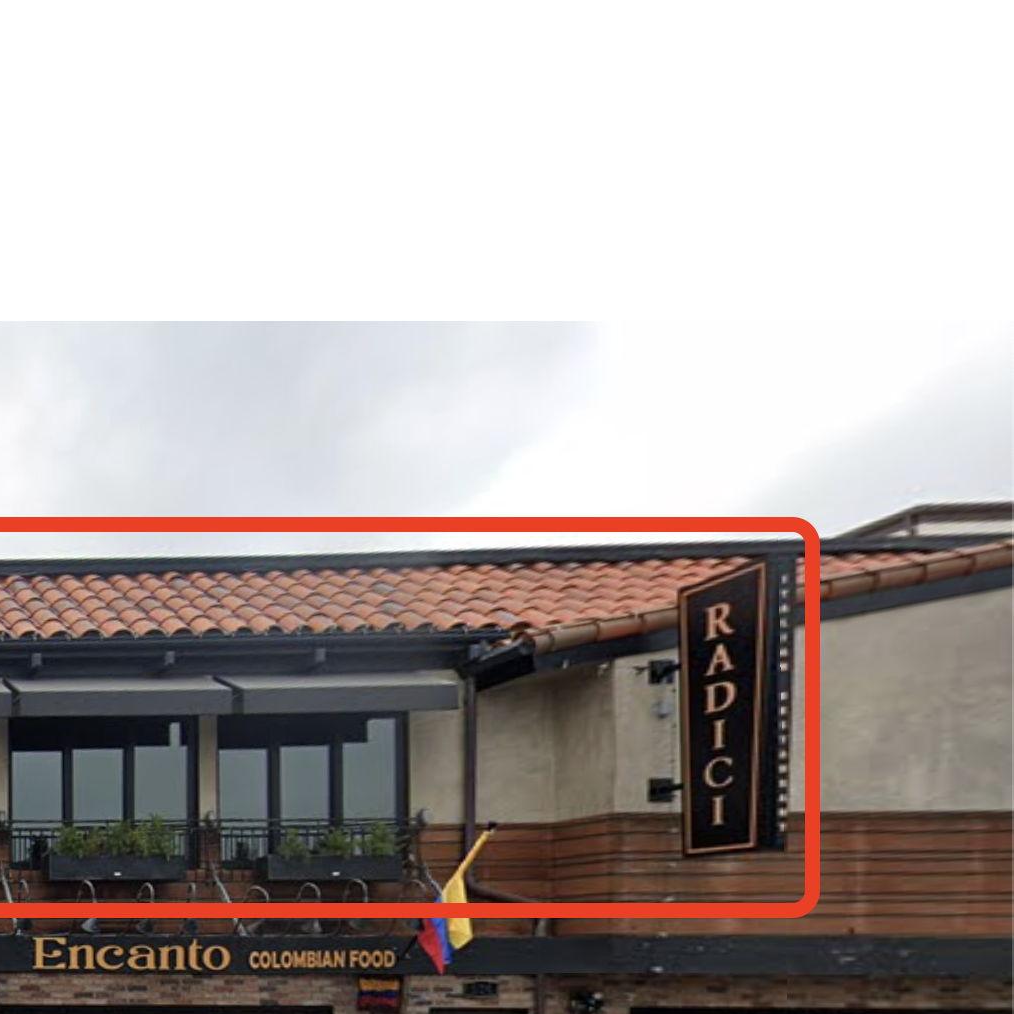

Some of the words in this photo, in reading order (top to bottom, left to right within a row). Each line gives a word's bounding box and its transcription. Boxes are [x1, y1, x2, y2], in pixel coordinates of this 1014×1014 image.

[703, 602, 736, 827] RADICI
[31, 936, 231, 971] Encanto
[248, 950, 345, 970] COLOMBIAN
[349, 949, 396, 969] FOOD
